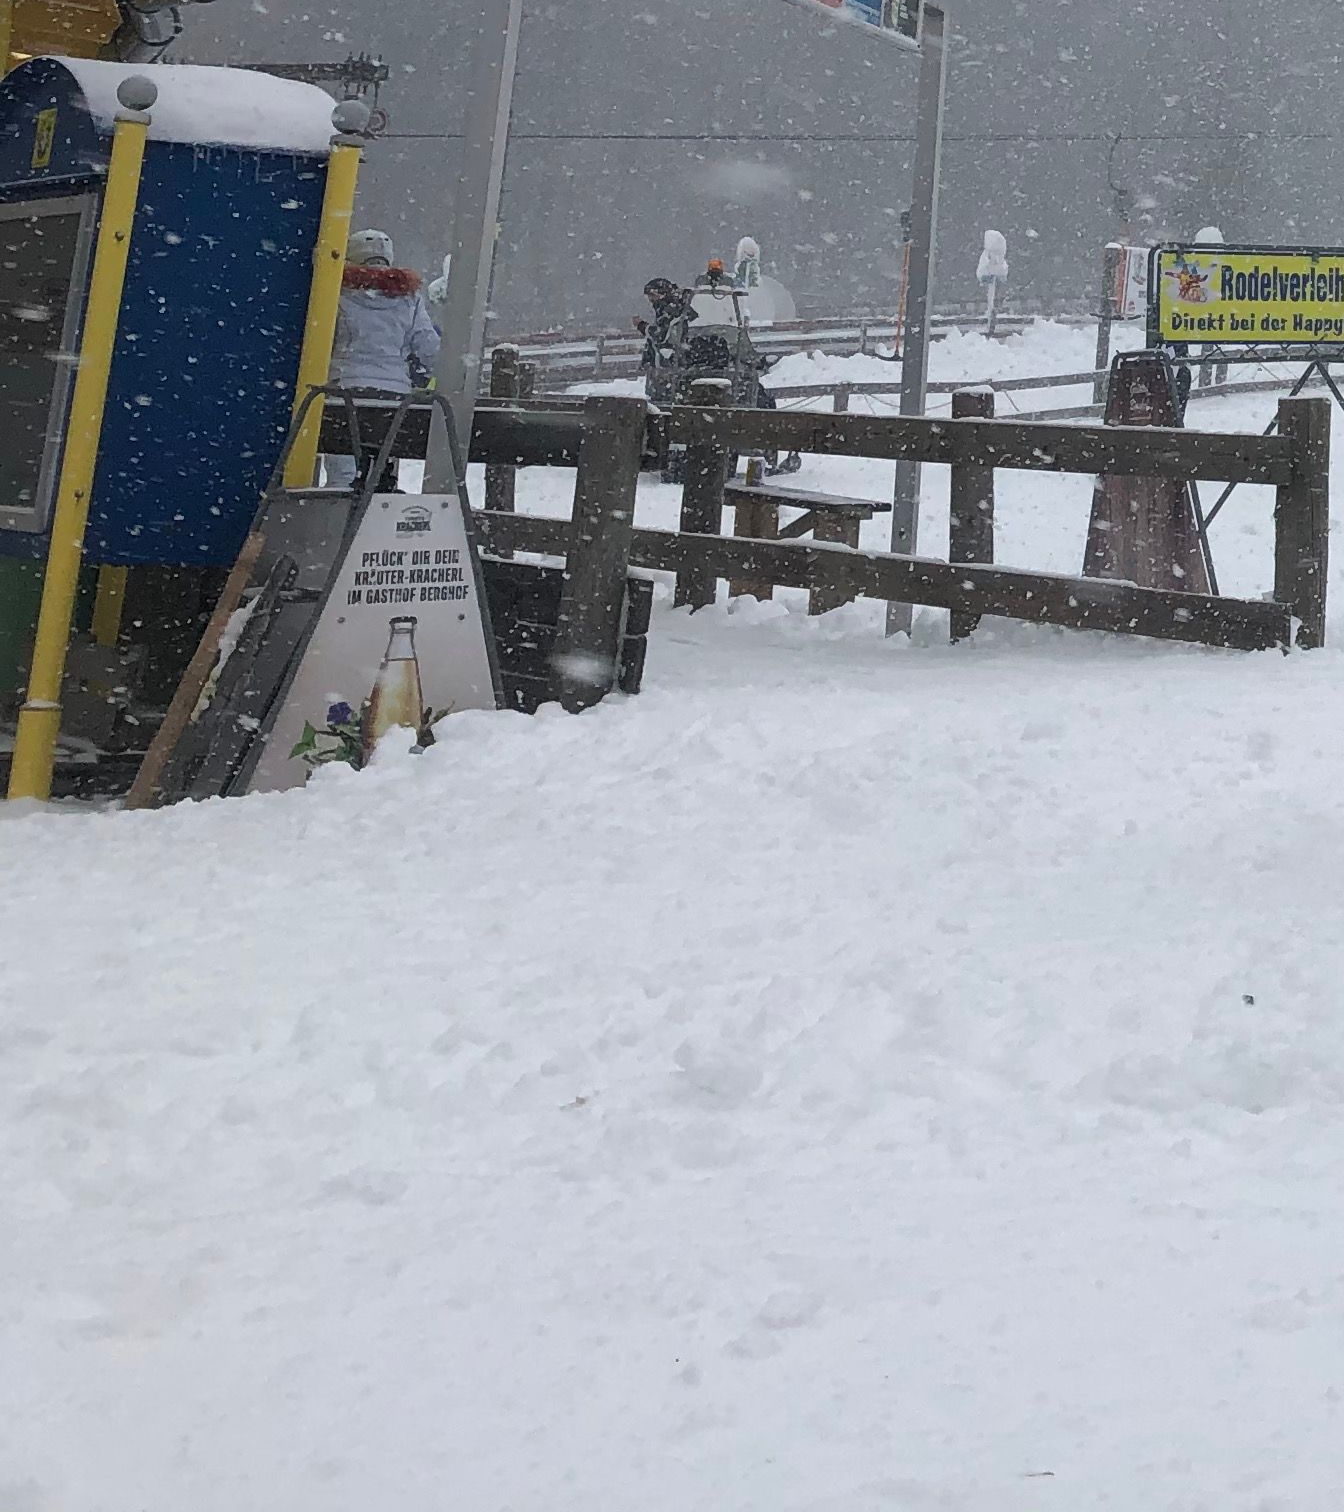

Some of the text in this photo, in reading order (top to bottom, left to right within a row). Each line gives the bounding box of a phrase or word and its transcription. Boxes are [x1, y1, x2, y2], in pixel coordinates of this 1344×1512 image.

[1171, 311, 1226, 332] Direkt
[1229, 311, 1256, 332] bei
[1260, 312, 1288, 332] der
[411, 550, 431, 566] DIR
[347, 589, 363, 605] IM
[366, 586, 417, 605] GASTHOF
